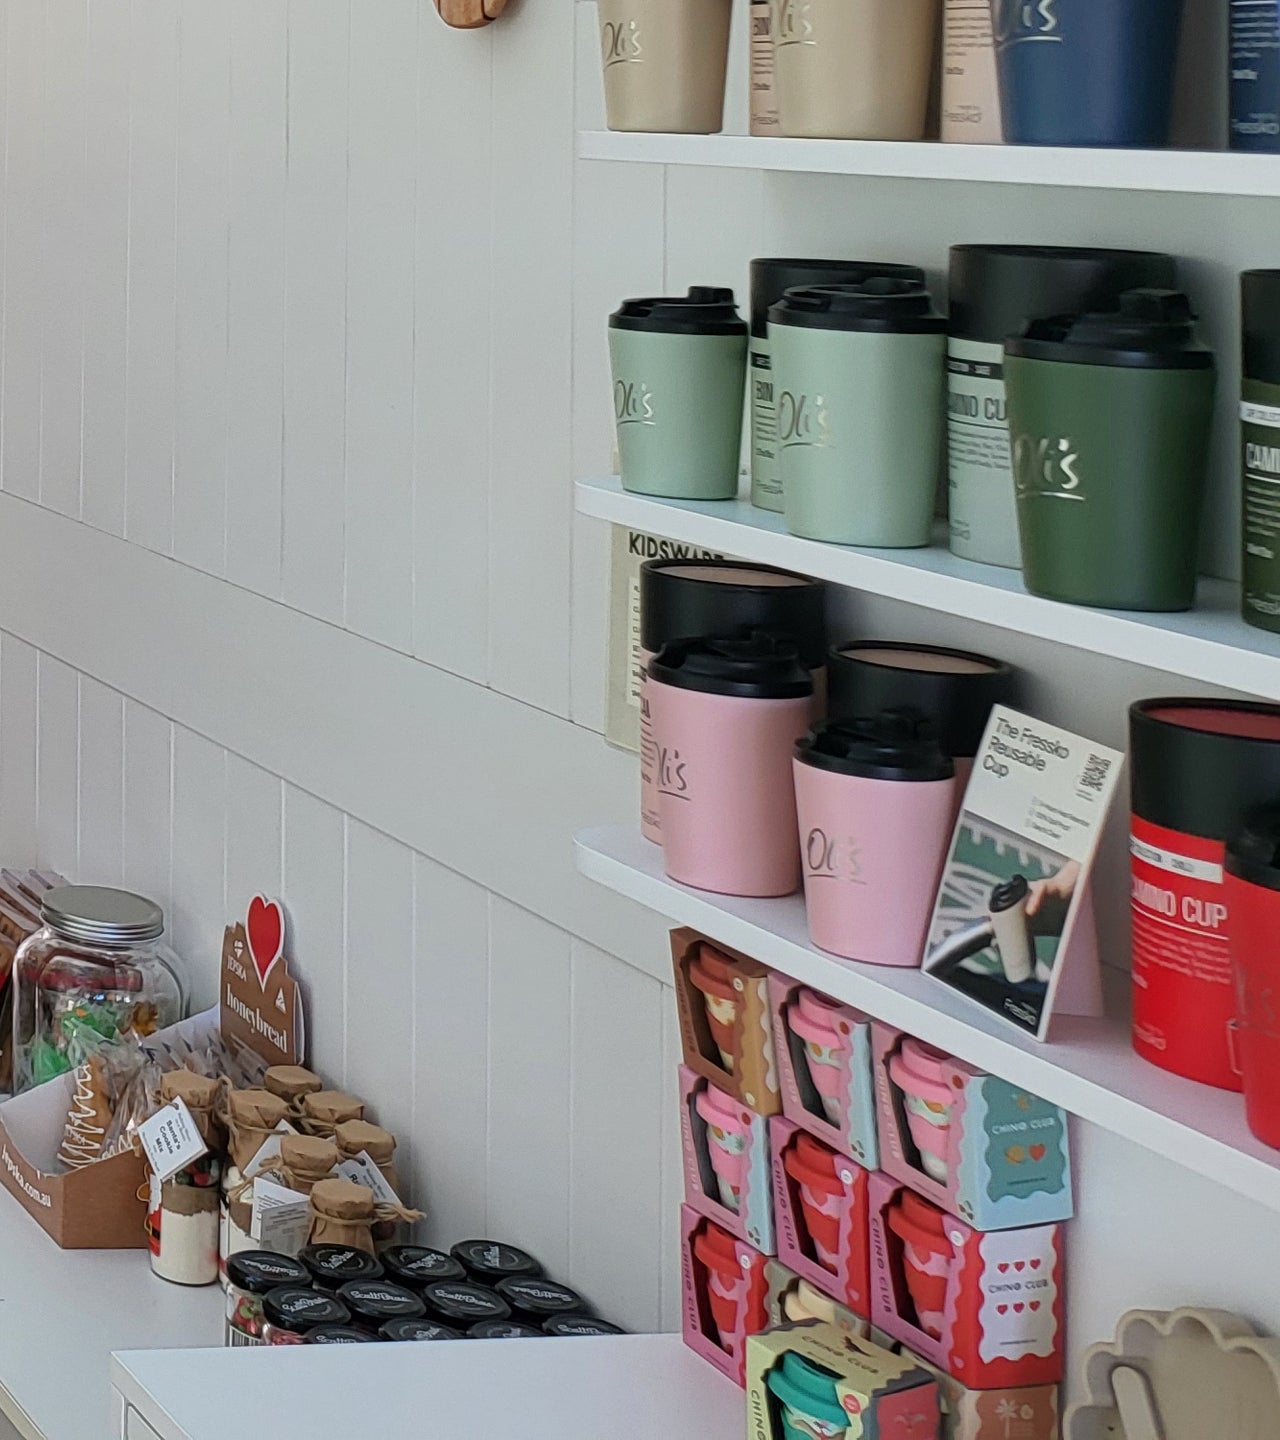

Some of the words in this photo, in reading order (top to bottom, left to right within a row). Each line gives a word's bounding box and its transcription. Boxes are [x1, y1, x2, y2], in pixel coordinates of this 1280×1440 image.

[984, 397, 1007, 421] CU
[988, 735, 1047, 772] Reusable
[996, 717, 1020, 738] The
[1020, 727, 1070, 760] Fressko
[983, 754, 1009, 778] Cup
[1181, 895, 1228, 929] CUP
[226, 983, 288, 1054] honeybread
